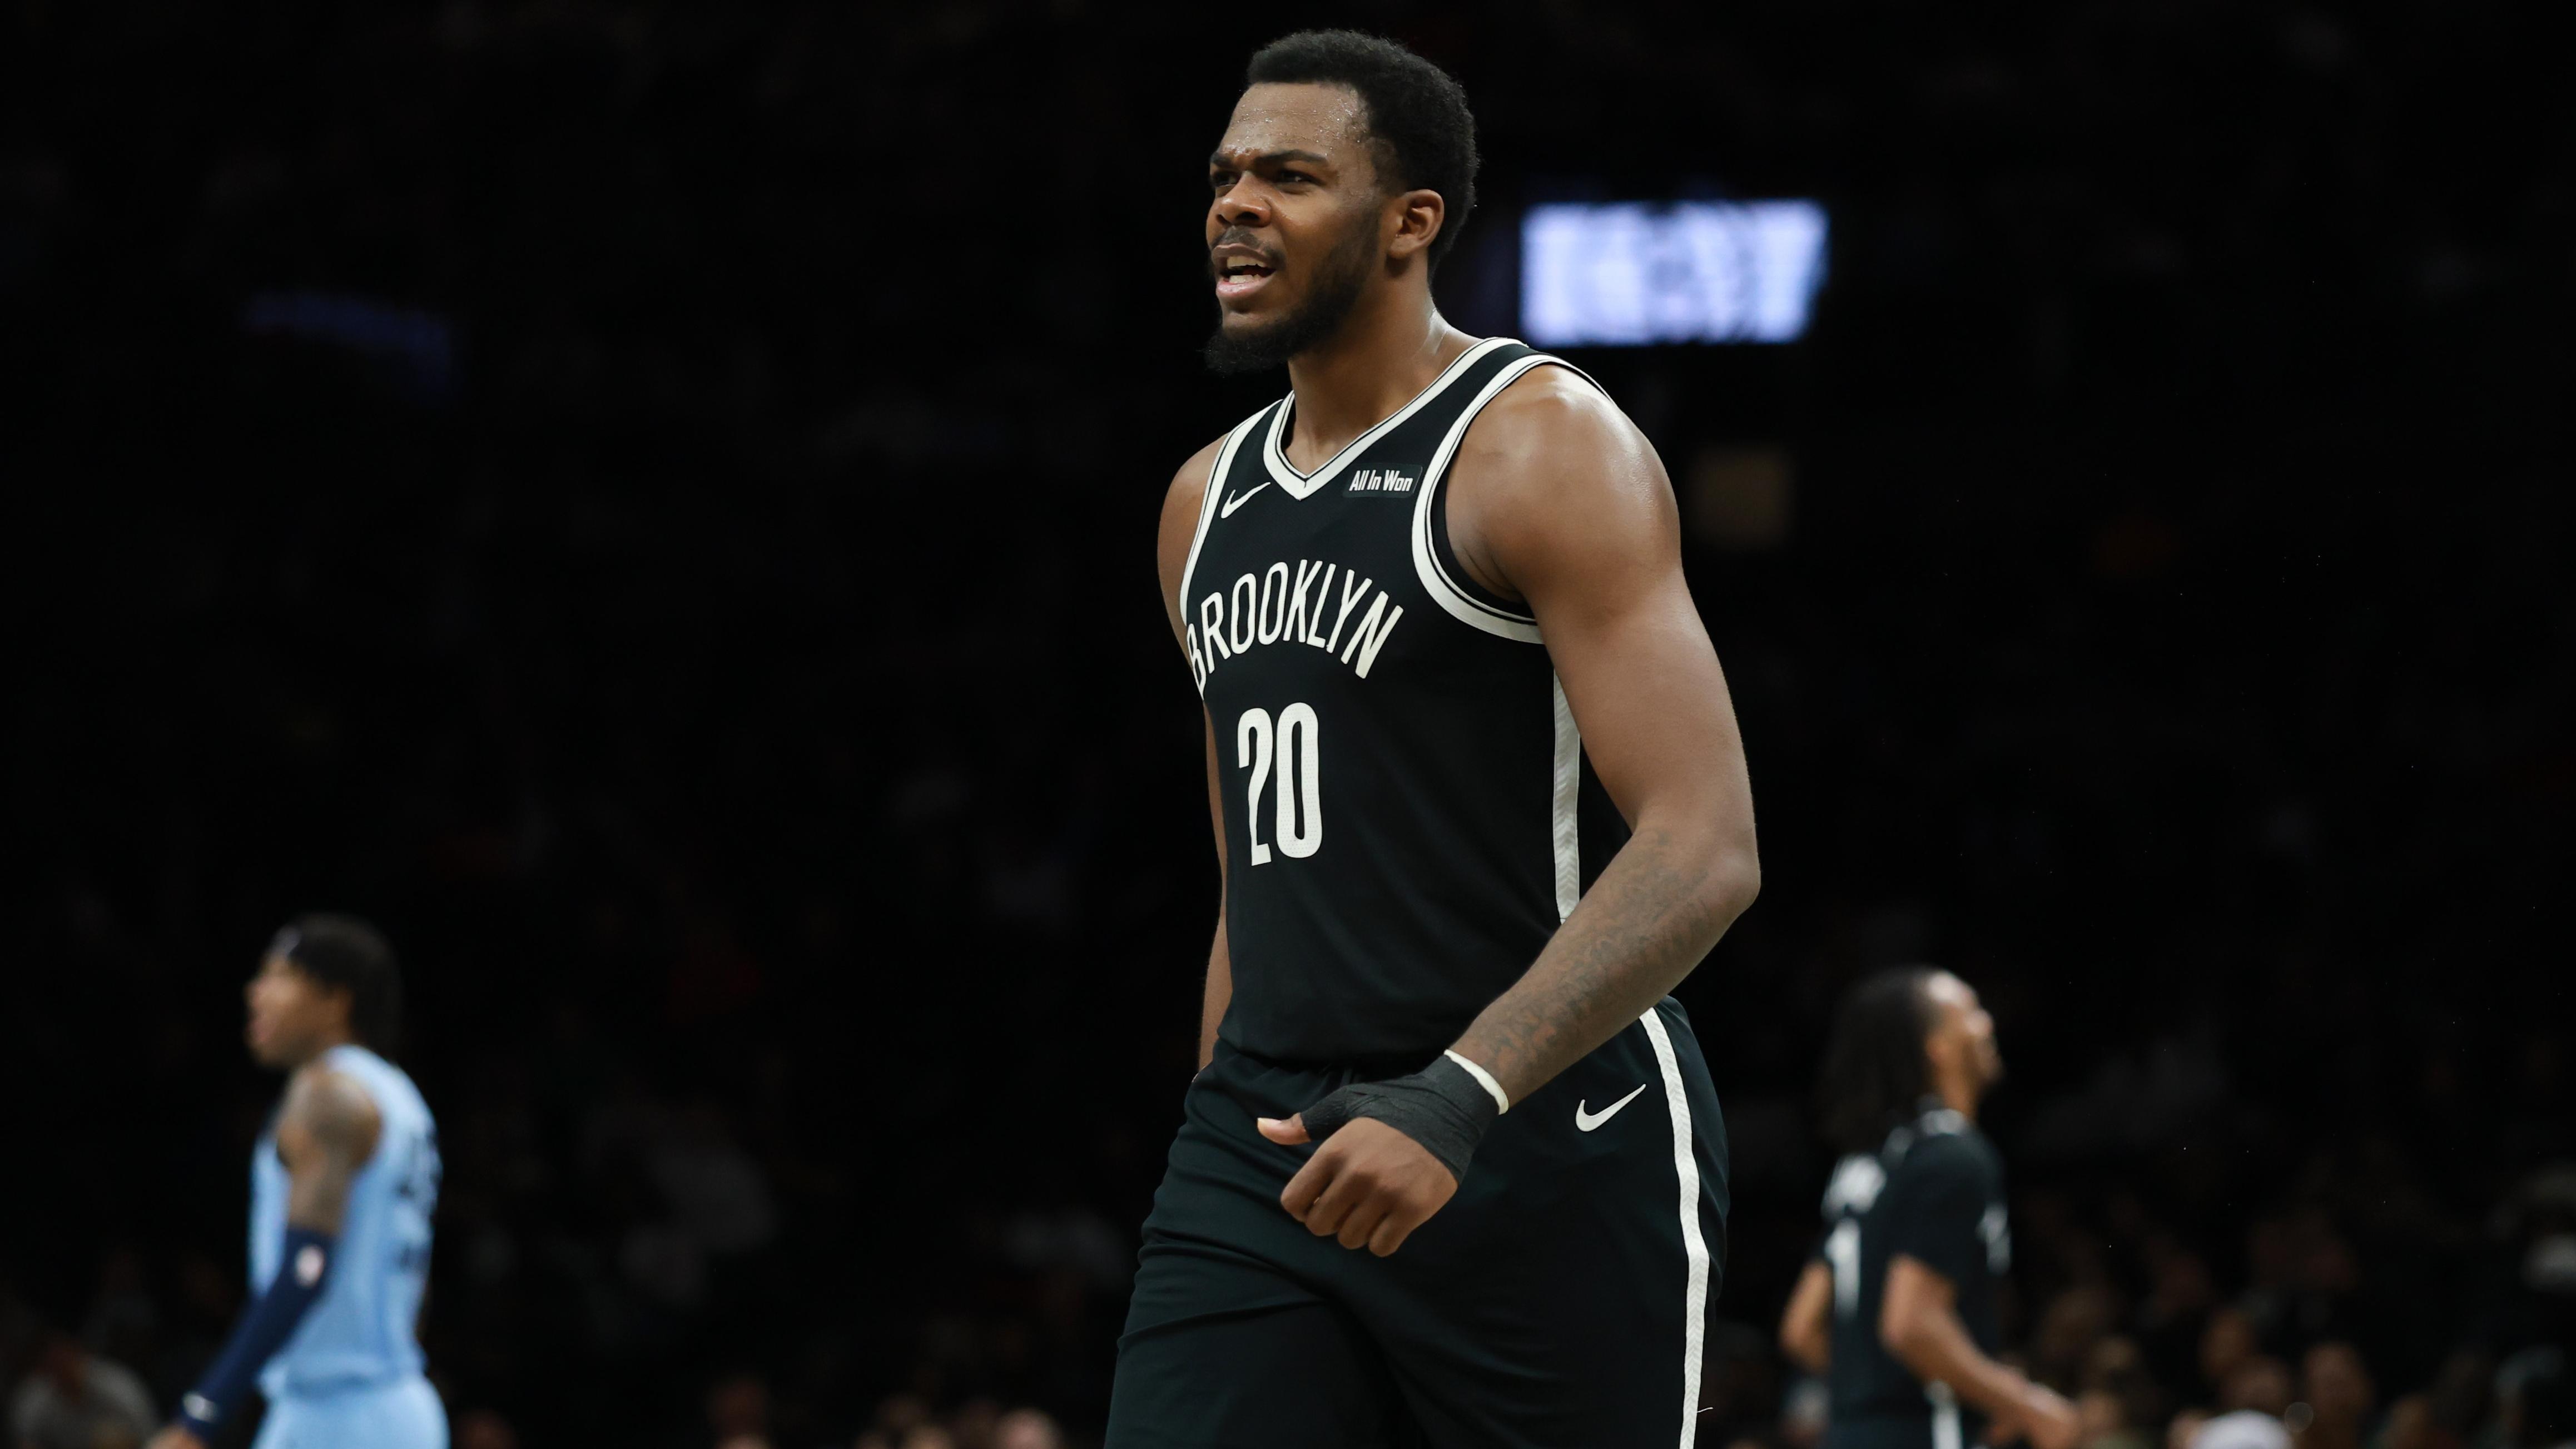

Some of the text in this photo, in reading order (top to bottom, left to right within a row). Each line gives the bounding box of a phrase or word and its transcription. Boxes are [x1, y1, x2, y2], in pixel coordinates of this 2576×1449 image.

[1348, 469, 1413, 492] All In Won
[1187, 559, 1404, 701] BROOKLYN
[1237, 702, 1323, 866] 20
